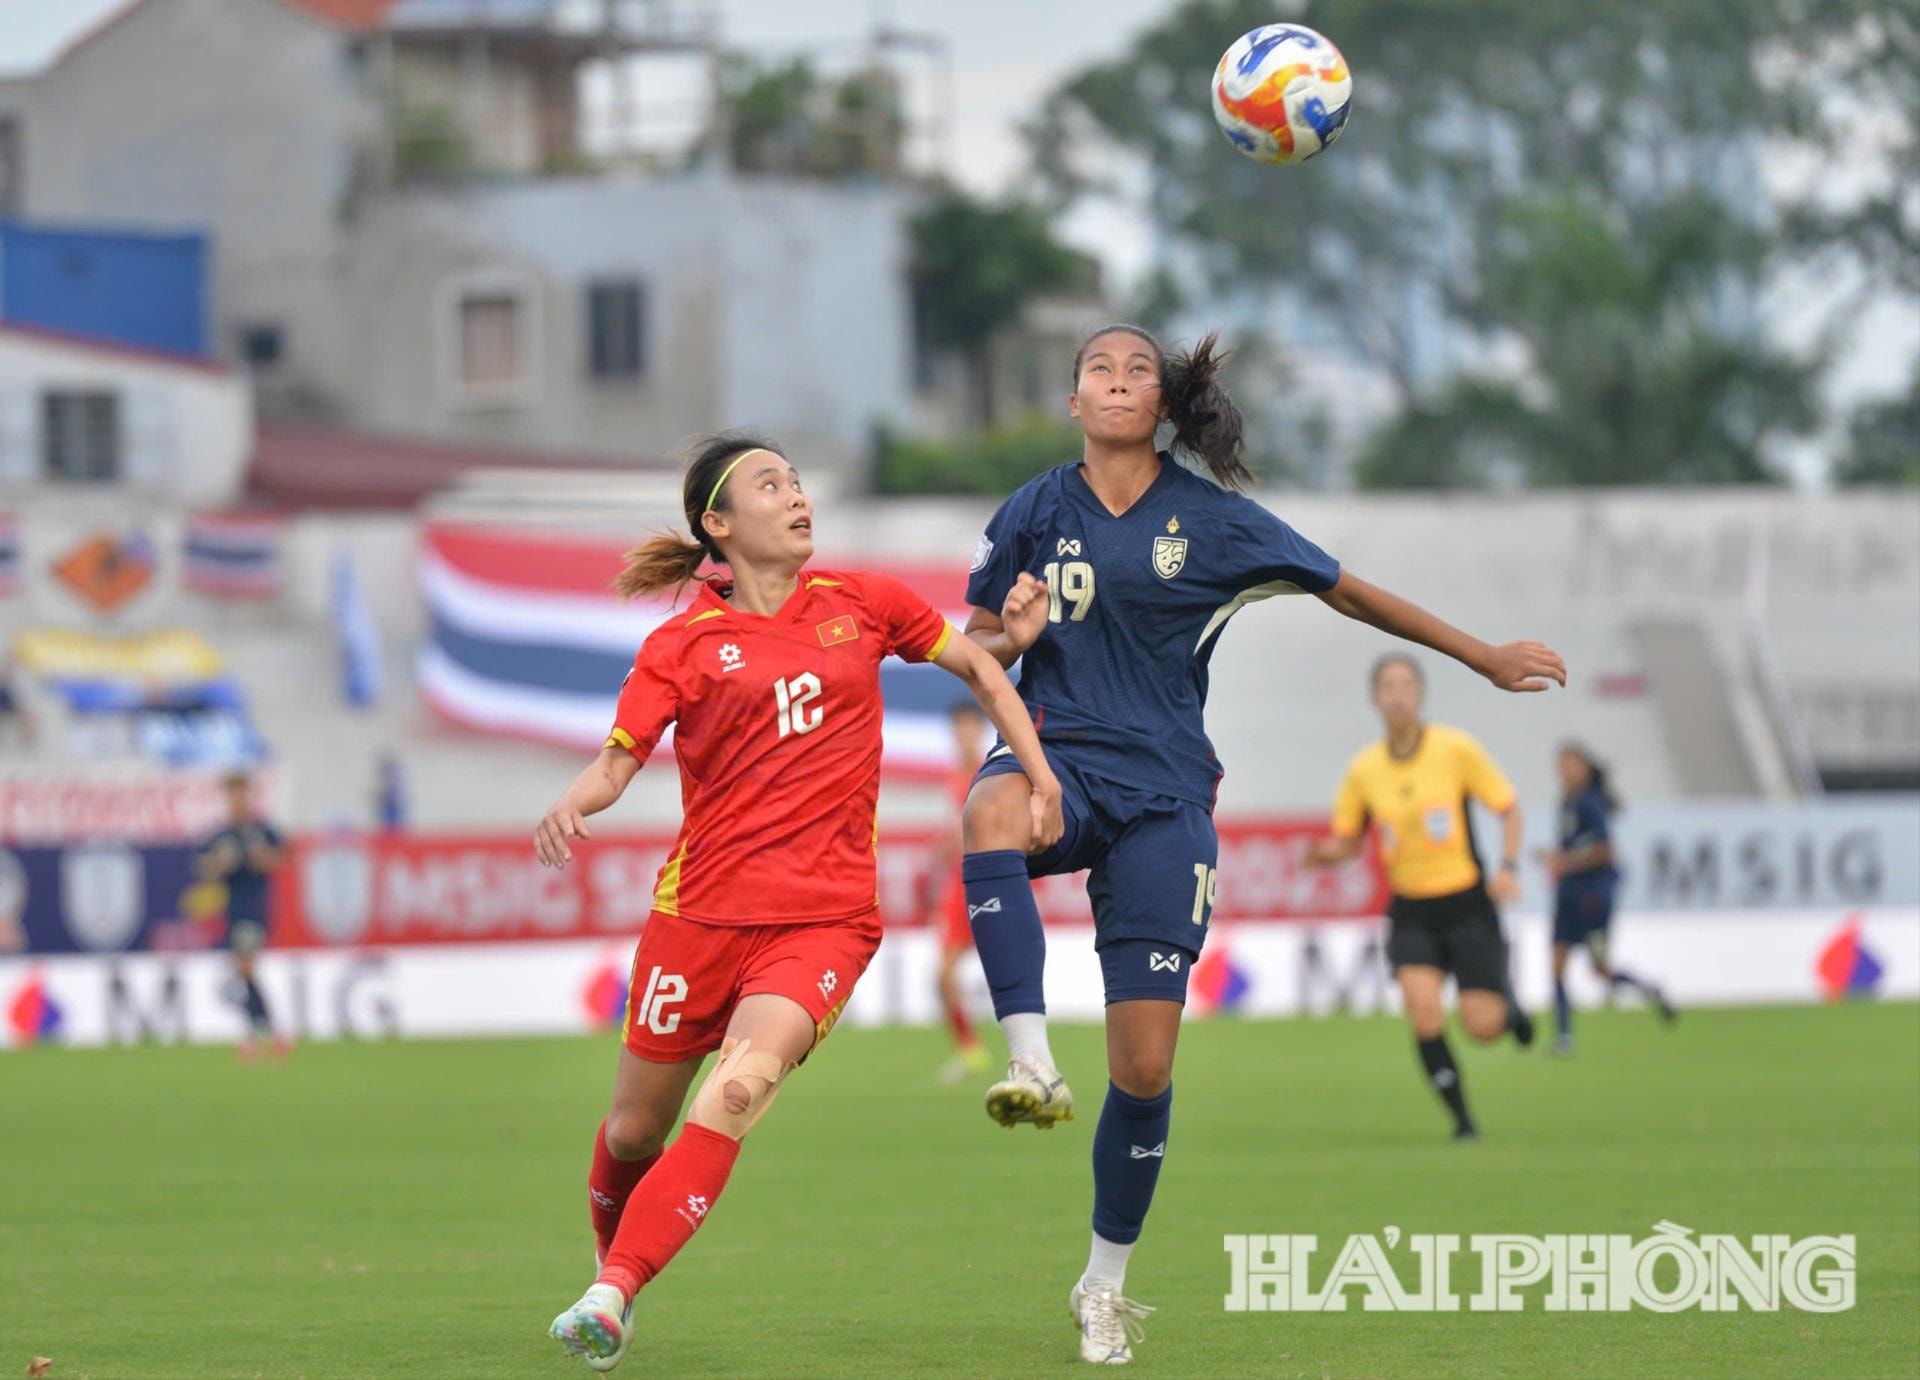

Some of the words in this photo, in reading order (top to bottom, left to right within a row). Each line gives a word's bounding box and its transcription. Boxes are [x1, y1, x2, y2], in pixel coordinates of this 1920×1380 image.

[1044, 562, 1095, 623] 19
[774, 671, 823, 739] 12
[1648, 832, 1884, 906] MSIG
[637, 966, 688, 1034] 12
